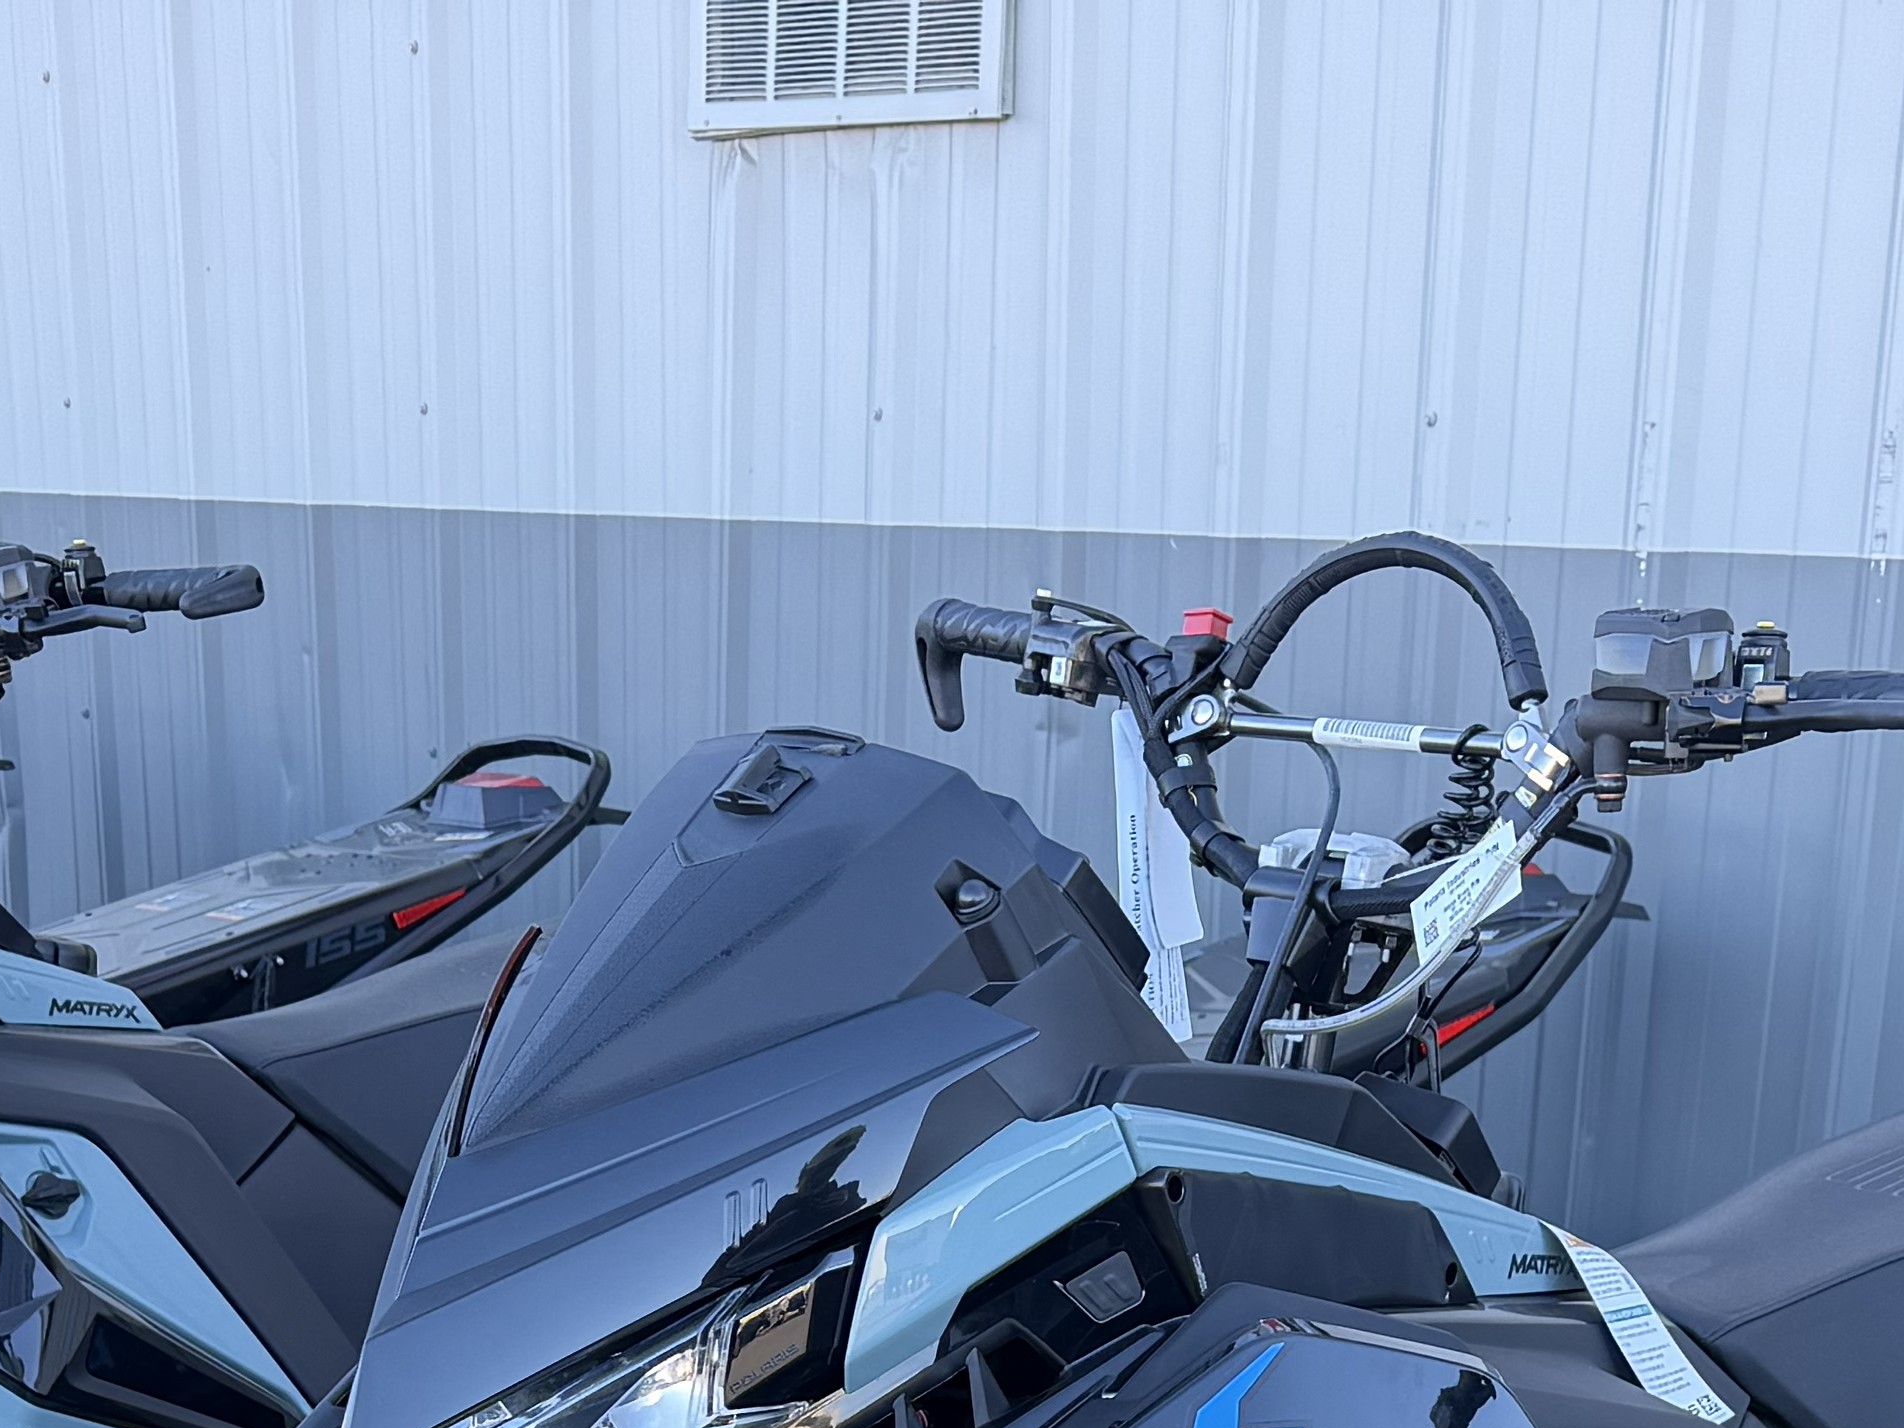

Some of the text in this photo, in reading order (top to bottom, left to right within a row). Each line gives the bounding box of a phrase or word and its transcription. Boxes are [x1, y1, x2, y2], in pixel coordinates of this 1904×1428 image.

[1128, 815, 1143, 932] atcher Operation
[305, 919, 386, 969] 155
[49, 998, 142, 1024] MATRYX
[730, 1344, 800, 1394] POLARIS
